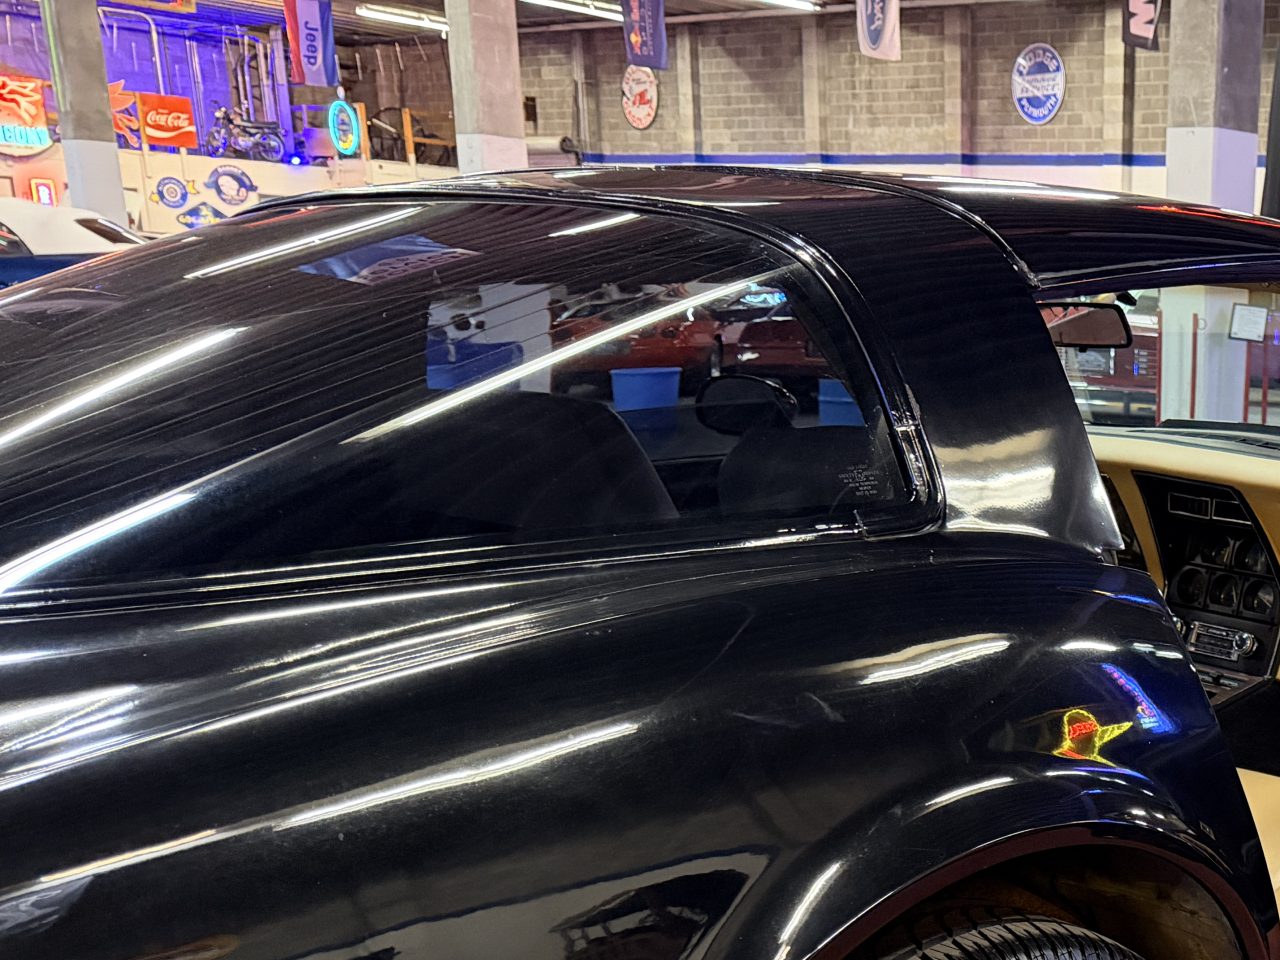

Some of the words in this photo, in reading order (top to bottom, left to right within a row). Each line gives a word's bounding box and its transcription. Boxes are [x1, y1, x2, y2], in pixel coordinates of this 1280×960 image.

[303, 21, 319, 66] Jeep
[1018, 49, 1059, 75] DODGE
[1021, 95, 1058, 118] PLYMOUTH
